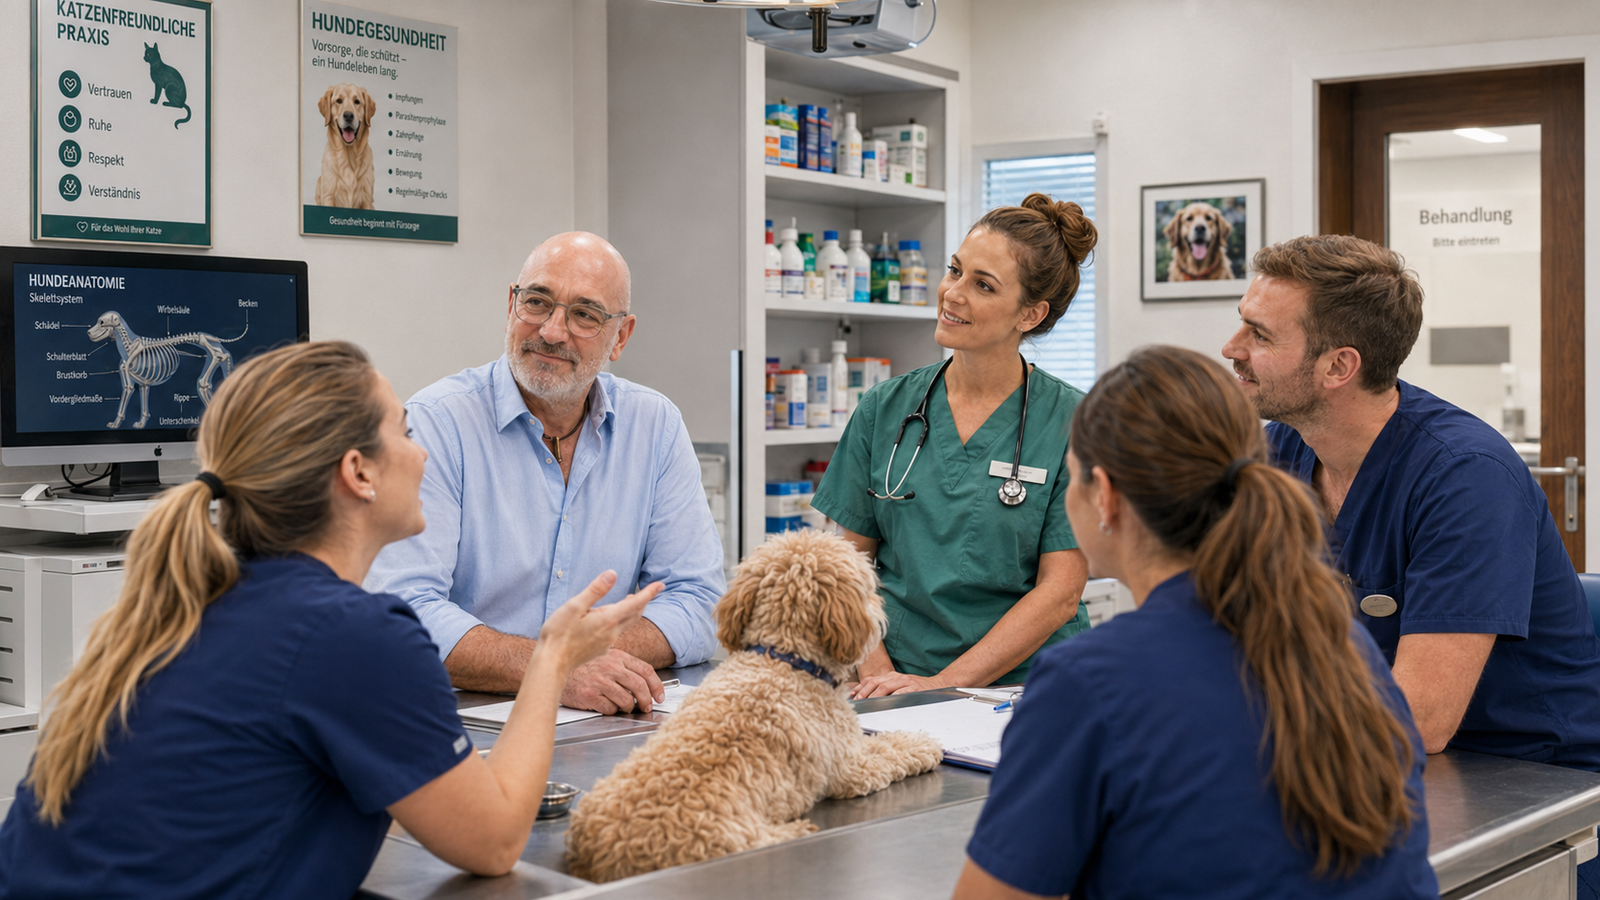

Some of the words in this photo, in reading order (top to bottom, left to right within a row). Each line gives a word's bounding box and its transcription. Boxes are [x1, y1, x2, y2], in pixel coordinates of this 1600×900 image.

[57, 0, 196, 38] KATZENFREUNDLICHE
[57, 22, 110, 46] PRAXIS
[312, 11, 447, 51] HUNDEGESUNDHEIT
[312, 38, 354, 58] Vorsorge,
[356, 46, 369, 58] die
[370, 49, 400, 63] schützt
[312, 55, 326, 67] ein
[327, 57, 378, 75] Hundeleben
[379, 65, 399, 80] lang.
[87, 83, 132, 100] Vertrauen
[395, 92, 424, 105] Impfungen
[88, 118, 112, 132] Ruhe
[88, 152, 125, 168] Respekt
[88, 185, 141, 200] Verständnis
[430, 190, 448, 199] Checks
[329, 215, 363, 227] Gesundheit
[363, 218, 385, 229] beginnt
[385, 220, 396, 229] mit
[396, 220, 420, 232] Fürsorge
[1419, 207, 1513, 226] Behandlung
[90, 223, 101, 232] Für
[101, 224, 114, 233] das
[113, 225, 130, 233] Wohl
[145, 226, 163, 235] Katze
[1432, 237, 1455, 247] Bitte
[1457, 235, 1500, 246] eintreten
[29, 273, 126, 289] HUNDEANATOMIE
[29, 292, 84, 305] Skelettsystem
[238, 299, 258, 308] Becken
[157, 305, 191, 315] Wirbelsäule
[34, 320, 61, 330] Schädel
[46, 352, 88, 361] Schulterblatt
[56, 370, 88, 380] Brustkorb
[173, 393, 191, 403] Rippe
